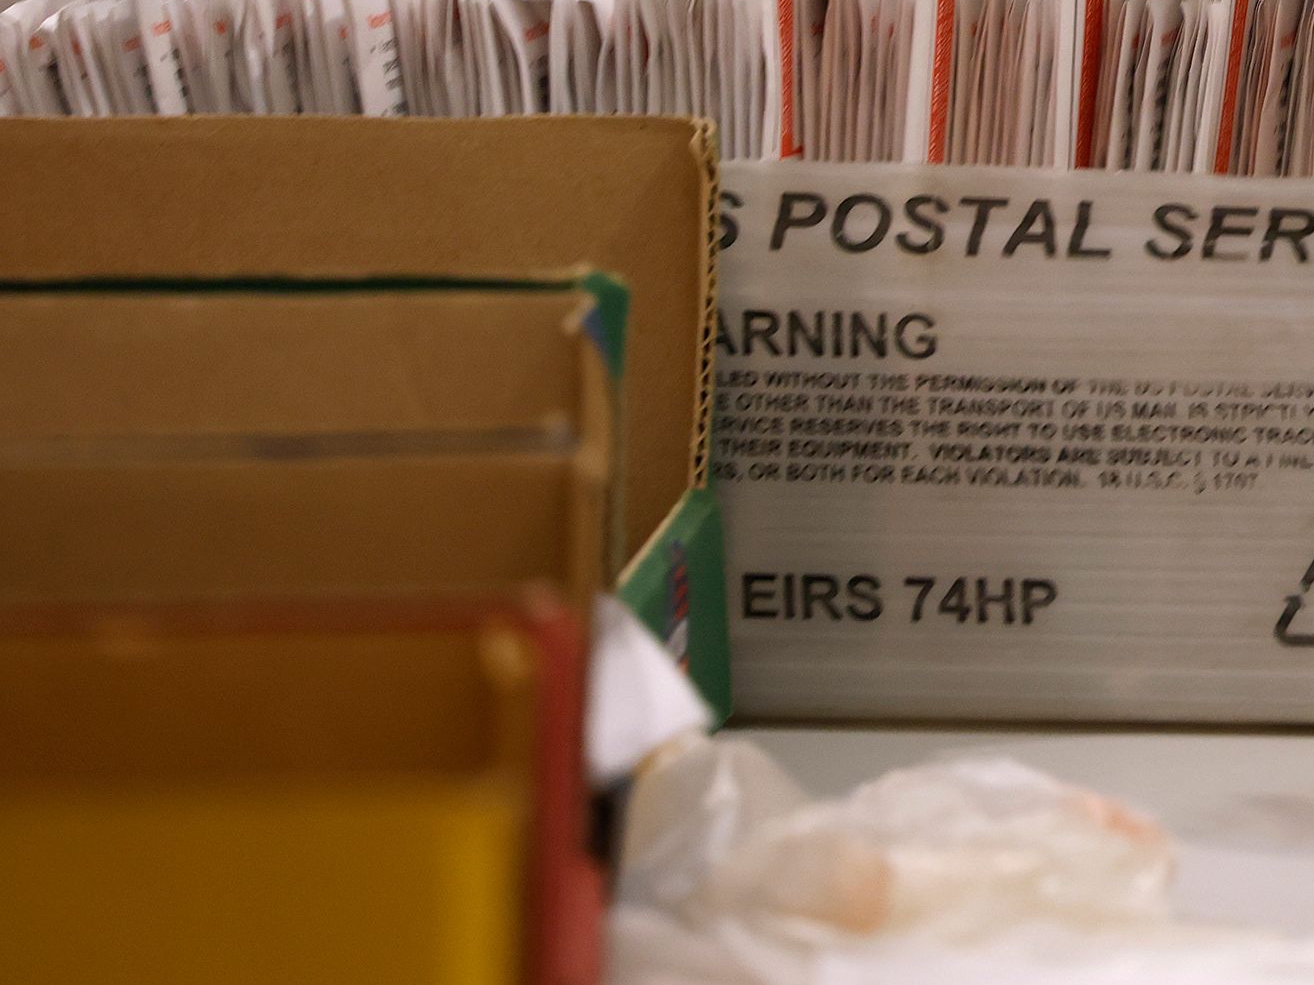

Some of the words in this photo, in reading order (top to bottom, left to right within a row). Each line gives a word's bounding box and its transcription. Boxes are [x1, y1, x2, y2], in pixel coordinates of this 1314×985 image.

[769, 191, 1112, 258] POSTAL
[763, 371, 861, 390] WITHOUT
[868, 373, 908, 390] THE
[915, 374, 1046, 394] PERMISSION
[1052, 378, 1079, 394] OF
[1089, 380, 1126, 395] THE
[735, 393, 808, 412] OTHER
[816, 394, 872, 414] THAN
[879, 396, 921, 415] THE
[927, 397, 1053, 417] TRANSPORT
[1061, 400, 1090, 418] OF
[1097, 401, 1126, 419] US
[1188, 402, 1208, 419] IS
[789, 418, 903, 437] RESERVES
[909, 420, 950, 437] THE
[957, 422, 1021, 439] RIGHT
[1028, 423, 1057, 440] TO
[1062, 424, 1104, 442] USE
[1111, 424, 1247, 444] ELECTRONIC
[719, 439, 781, 457] THEIR
[929, 443, 1051, 463] VIOLATORS
[1056, 447, 1100, 464] ARE
[749, 464, 780, 481] OR
[786, 464, 846, 483] BOTH
[852, 465, 896, 484] FOR
[900, 466, 961, 485] EACH
[742, 573, 884, 622] EIRS
[904, 576, 1059, 625] 74HP
